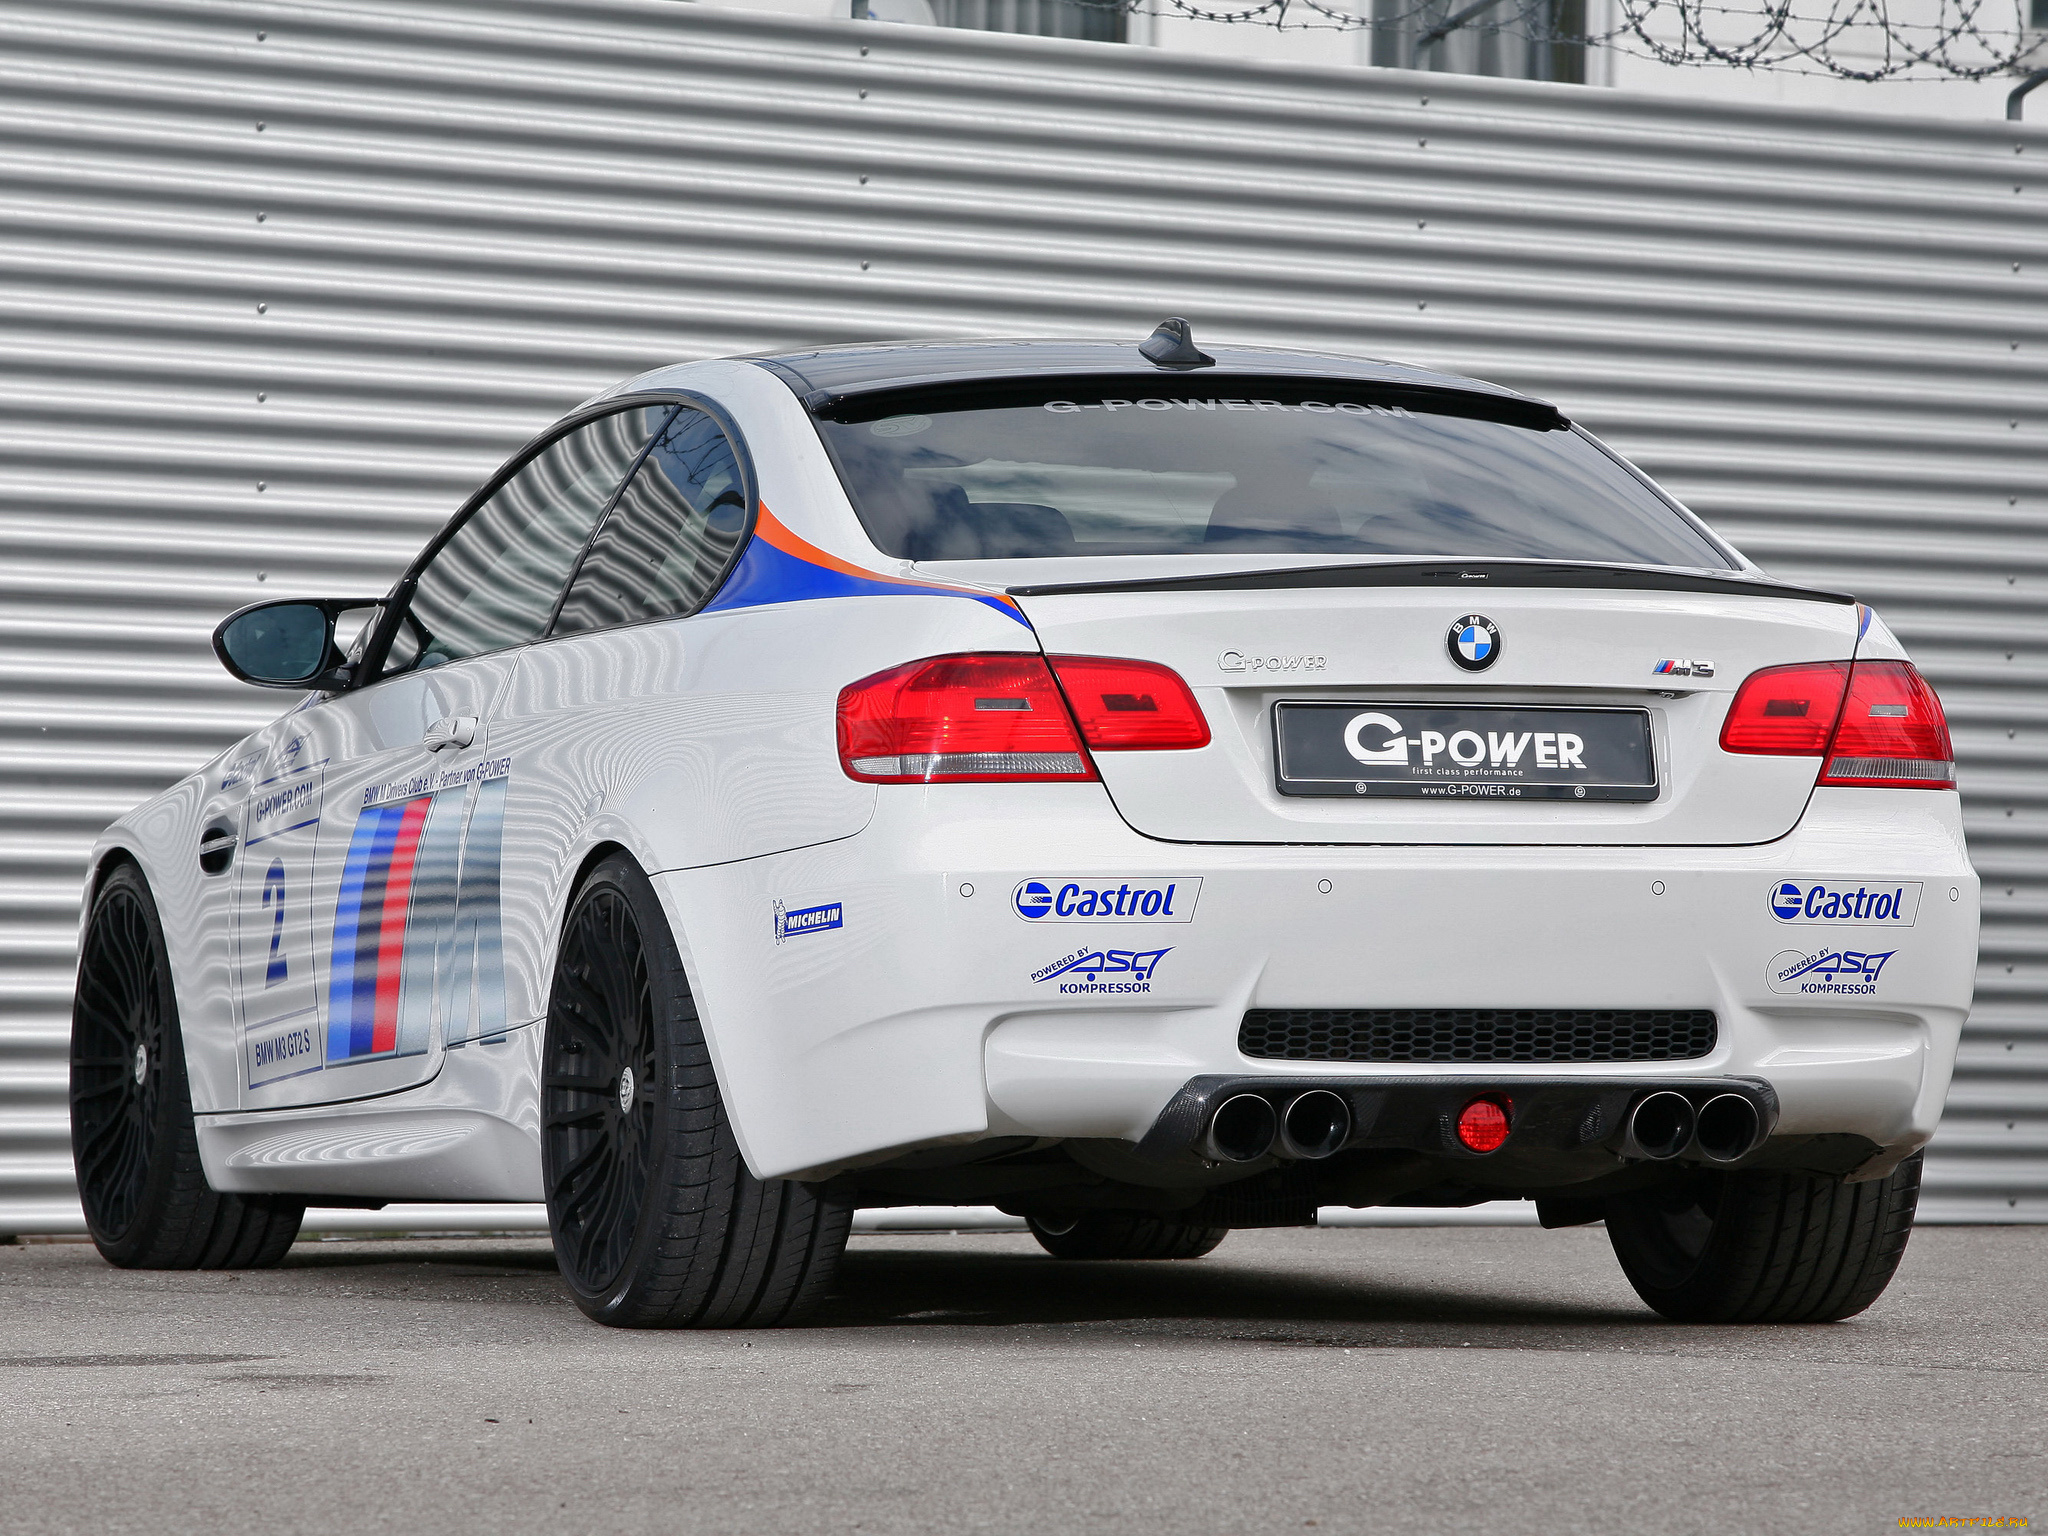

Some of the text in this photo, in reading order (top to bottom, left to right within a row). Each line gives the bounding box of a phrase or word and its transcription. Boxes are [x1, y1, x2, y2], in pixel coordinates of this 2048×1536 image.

[1043, 398, 1417, 419] G-POWER.COM
[1452, 615, 1498, 635] BMW
[1217, 648, 1328, 674] G-POWER
[1654, 658, 1715, 679] M3
[1344, 712, 1587, 769] G-POWER
[439, 768, 463, 788] Partner
[476, 757, 512, 780] G-POWER
[1412, 766, 1524, 777] first class performance
[256, 781, 313, 823] G-POWER.COM
[1421, 784, 1522, 796] www.G-POWER.de
[1055, 883, 1177, 917] Castrol
[1804, 886, 1903, 920] Castrol
[261, 857, 289, 990] 2
[787, 907, 840, 930] MICHELIN
[1030, 946, 1091, 981] POWERED BY
[1777, 946, 1831, 980] POWERED BY
[1059, 983, 1151, 994] KOMPRESSOR
[1801, 983, 1876, 994] KOMPRESSOR
[256, 1028, 311, 1067] BMW M3 GT2 S
